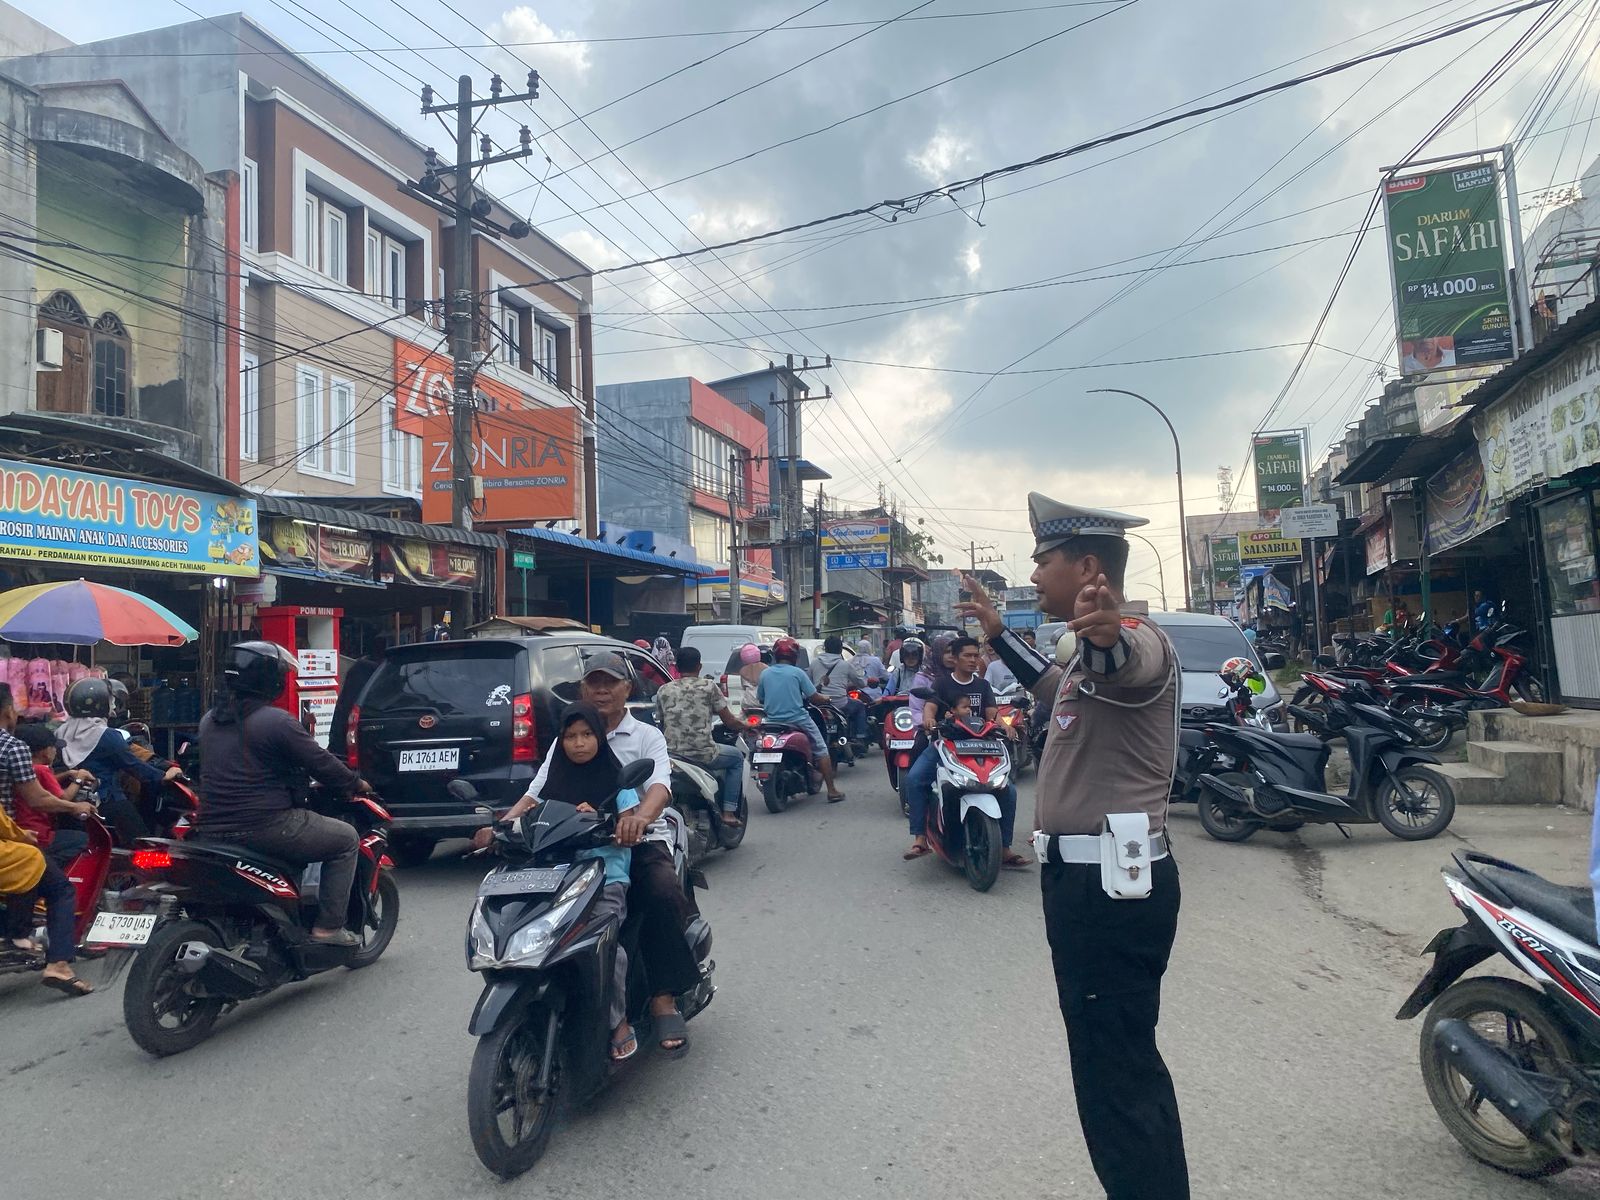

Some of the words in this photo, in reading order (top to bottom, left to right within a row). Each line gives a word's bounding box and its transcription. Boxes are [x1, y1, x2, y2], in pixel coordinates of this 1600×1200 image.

[1455, 166, 1491, 181] LEBIH
[1395, 219, 1499, 262] SAFARI
[1421, 277, 1477, 298] 14.000
[1257, 460, 1300, 475] SAFARI
[481, 477, 502, 487] mbira
[0, 467, 124, 524] IDAYAH
[130, 488, 200, 534] TOYS
[36, 525, 77, 542] MAINAN
[79, 529, 105, 545] ANAK
[107, 532, 128, 547] DAN
[130, 535, 188, 554] ACCESSORIES
[1244, 542, 1298, 555] SALSABILA
[38, 550, 86, 561] PERDAMAIAN
[88, 554, 107, 563] KOTA
[108, 556, 160, 568] KUALASIMPANG
[161, 561, 178, 569] ACEH
[180, 563, 206, 571] TAMIANG
[300, 606, 317, 615] POM
[318, 607, 334, 616] MINI
[401, 753, 413, 764] BK
[415, 752, 436, 764] 1761
[439, 750, 457, 763] AEM
[236, 860, 288, 888] VARIO
[95, 915, 105, 927] BL
[109, 916, 133, 929] 5730
[133, 917, 152, 930] UAS
